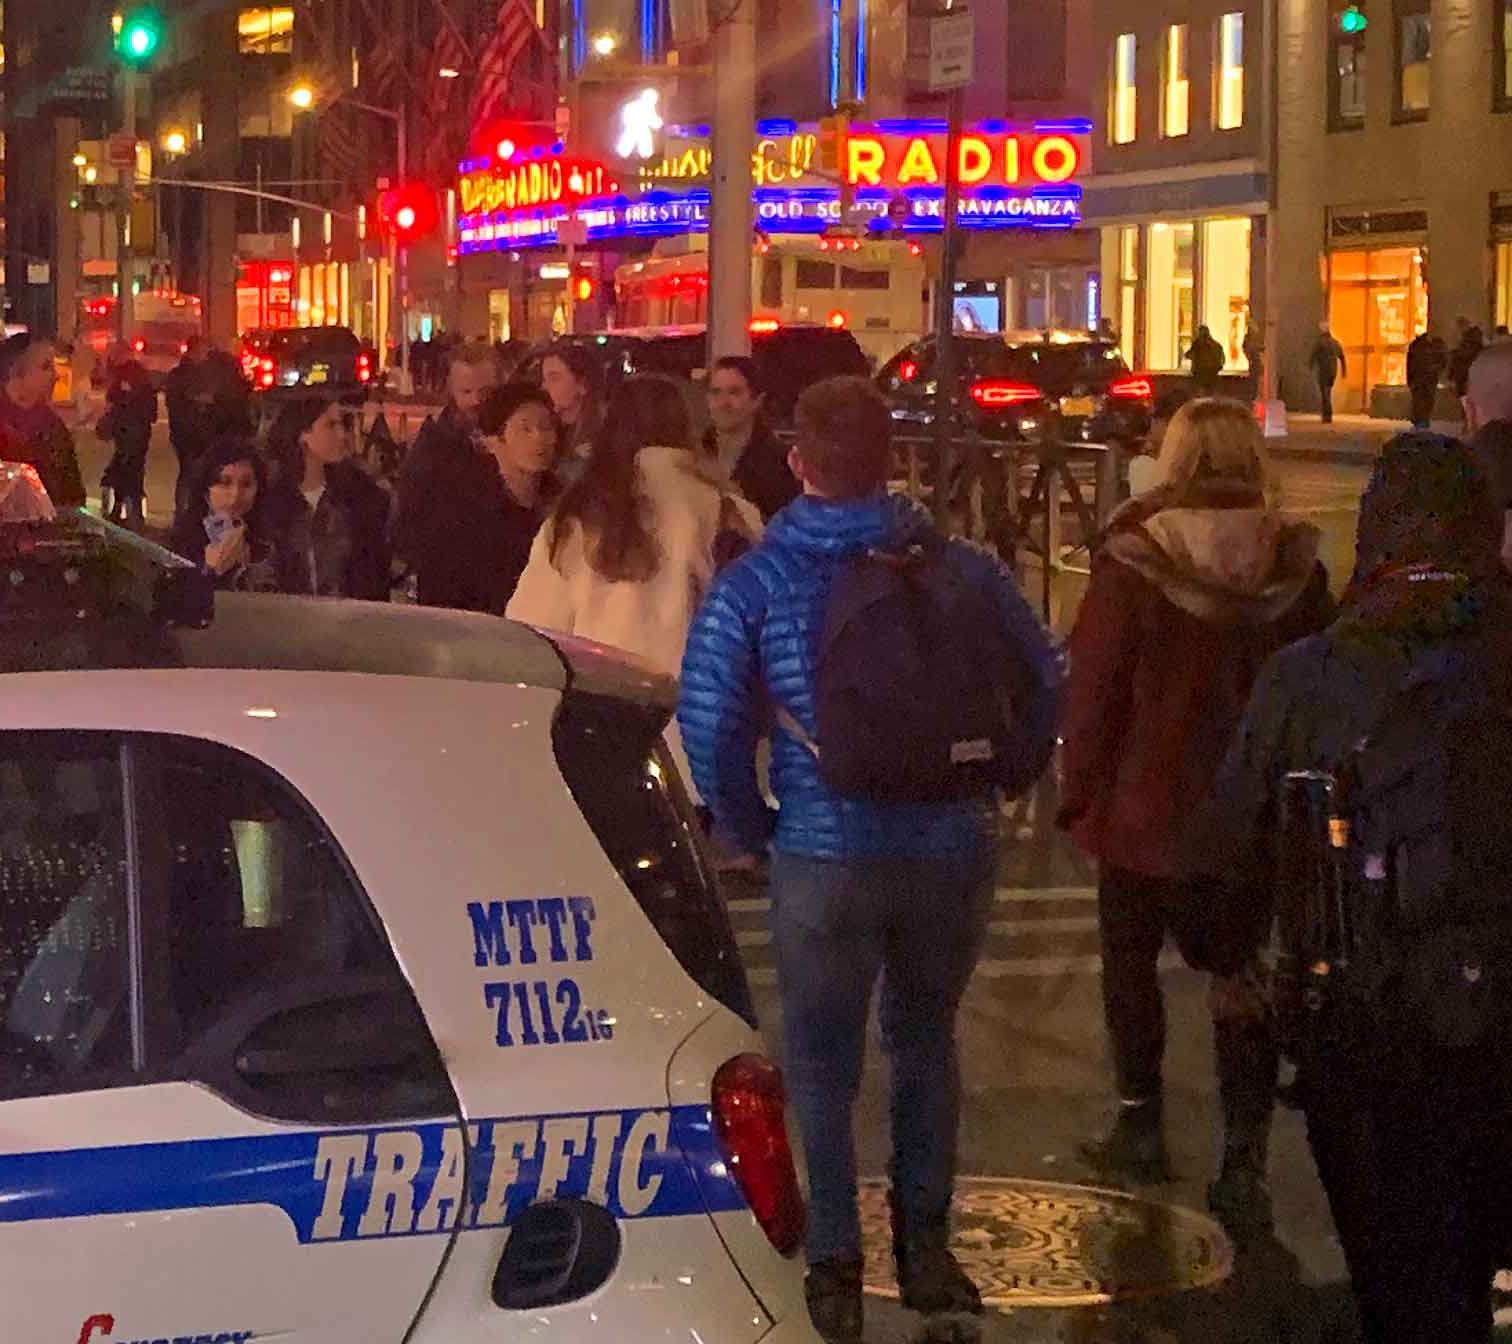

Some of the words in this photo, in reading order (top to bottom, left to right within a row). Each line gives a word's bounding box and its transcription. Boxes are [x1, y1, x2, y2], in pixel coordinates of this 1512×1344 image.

[847, 137, 1077, 185] RADIO
[759, 202, 803, 218] OLD
[914, 197, 1077, 217] EXRAVAGANZA
[467, 896, 596, 967] MTTF
[310, 1112, 673, 1239] TRAFFIC
